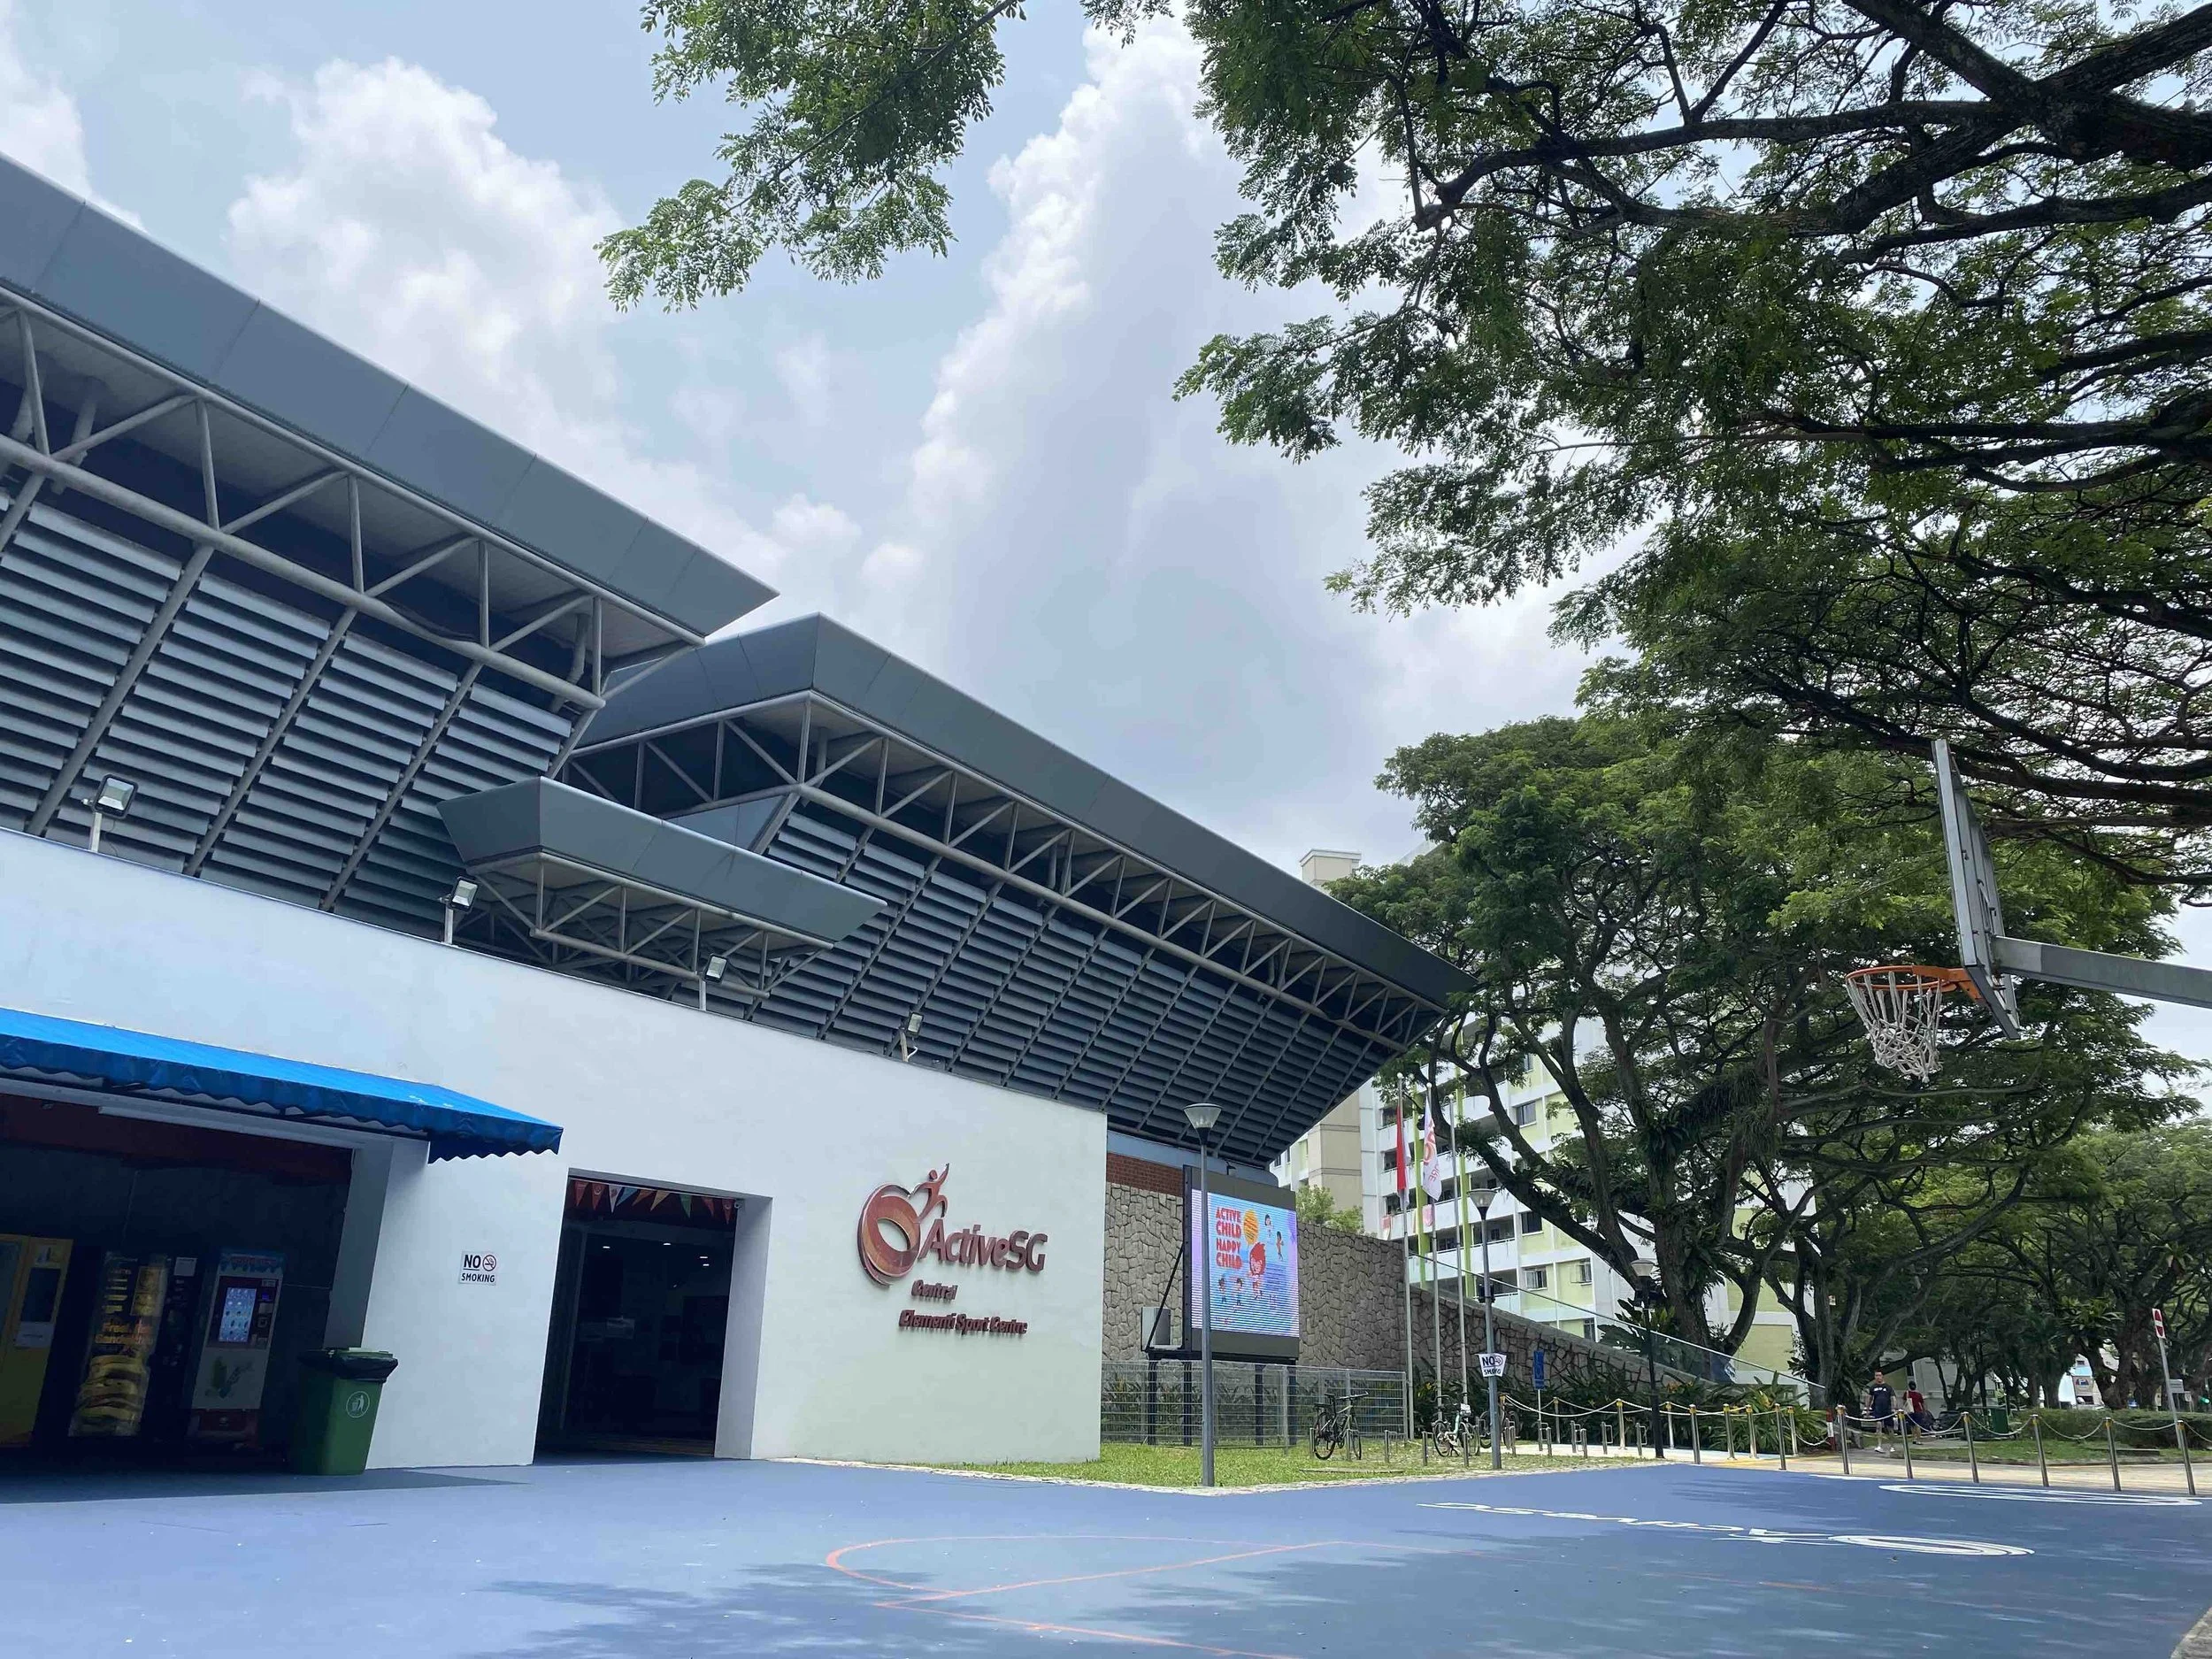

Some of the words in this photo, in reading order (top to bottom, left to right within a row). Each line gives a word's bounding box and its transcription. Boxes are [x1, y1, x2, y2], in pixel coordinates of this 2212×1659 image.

[1215, 1207, 1241, 1224] ACTIVE
[1216, 1220, 1241, 1239] CHILD
[918, 1218, 1048, 1272] ActiveSG
[1216, 1237, 1241, 1255] HAPPY
[464, 1254, 481, 1268] NO
[1216, 1252, 1243, 1270] CHILD
[461, 1272, 495, 1283] SMOKING
[911, 1279, 958, 1301] Central
[899, 1310, 956, 1330] Clementi
[956, 1313, 990, 1335] Sport
[989, 1316, 1028, 1334] Centre
[1481, 1356, 1495, 1366] NO
